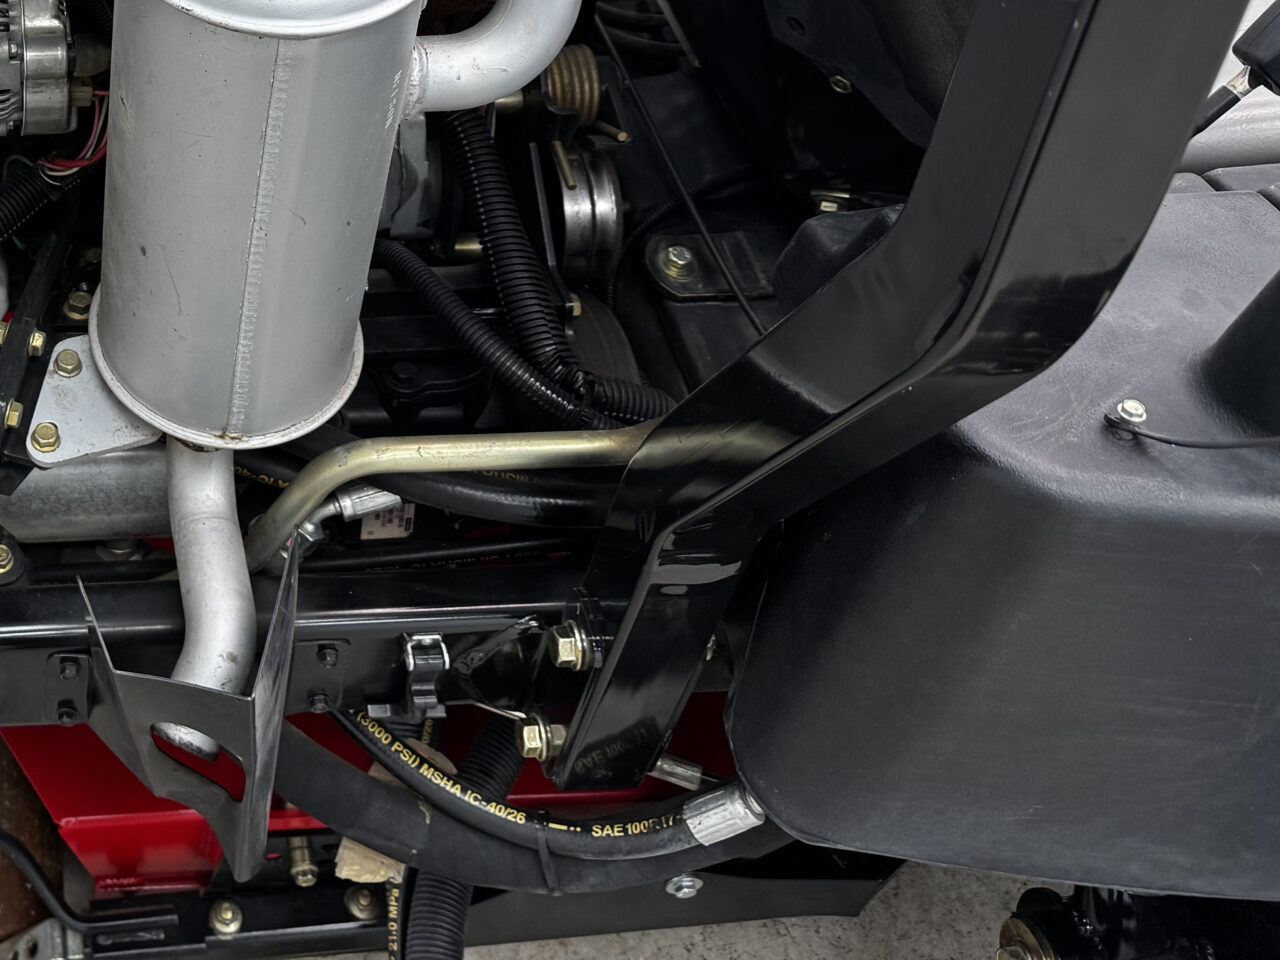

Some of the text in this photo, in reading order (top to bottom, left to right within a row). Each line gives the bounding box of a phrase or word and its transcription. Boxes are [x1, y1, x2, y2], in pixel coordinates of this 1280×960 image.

[356, 711, 527, 824] (3000 PSI) MSHA IC-40/26
[591, 824, 625, 837] SAE
[388, 888, 400, 919] MPa
